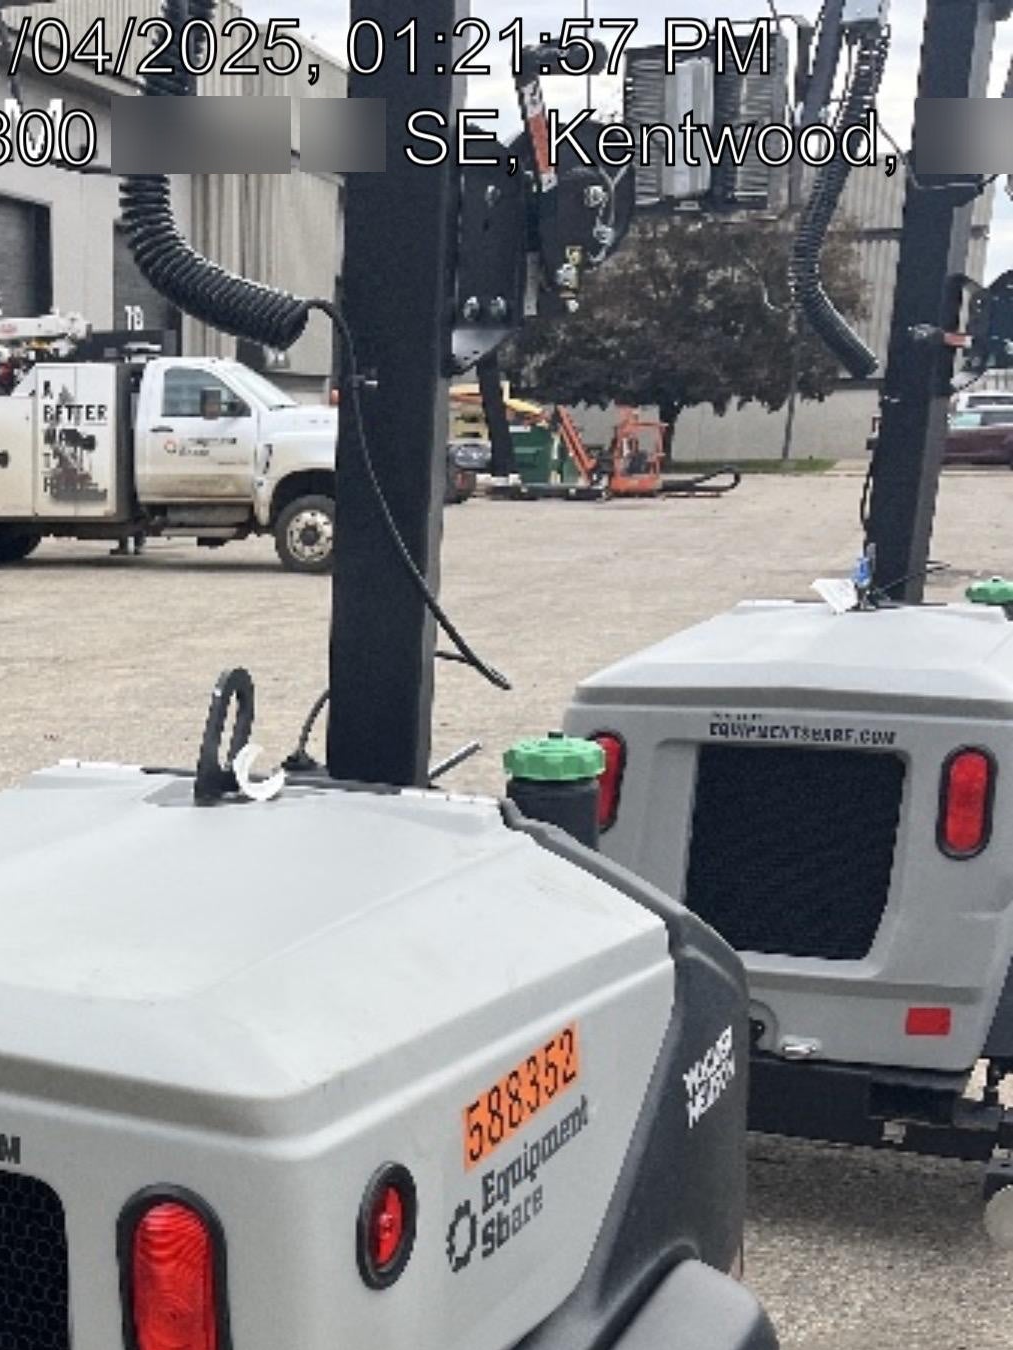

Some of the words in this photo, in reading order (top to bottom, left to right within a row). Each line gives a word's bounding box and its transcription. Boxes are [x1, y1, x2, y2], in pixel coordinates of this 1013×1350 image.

[43, 404, 108, 423] BETTER
[467, 1027, 578, 1164] 588352
[481, 1094, 590, 1215] Equipment
